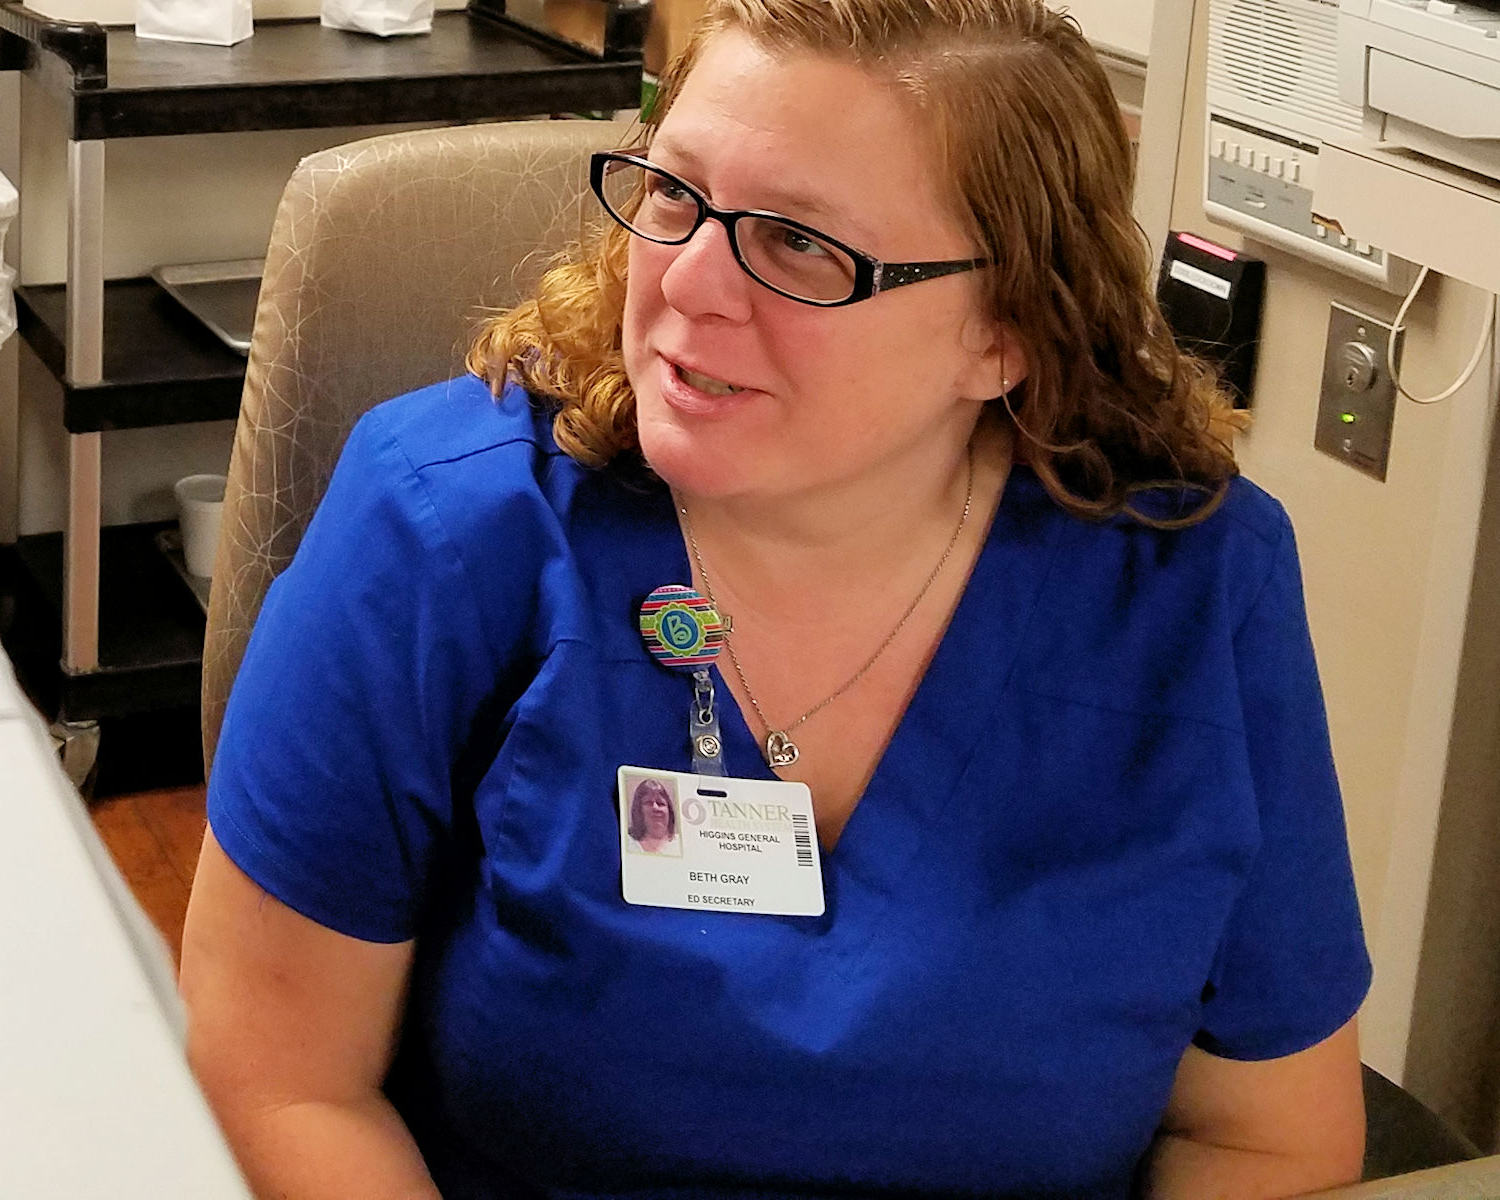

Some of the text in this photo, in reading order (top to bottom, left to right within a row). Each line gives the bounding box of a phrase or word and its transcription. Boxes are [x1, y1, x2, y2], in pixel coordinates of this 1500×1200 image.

[666, 614, 693, 645] B
[708, 800, 793, 821] TANNER
[699, 830, 781, 844] HIGGINS GENERAL
[719, 842, 763, 853] HOSPITAL
[689, 871, 750, 885] BETH GRAY
[687, 894, 756, 907] ED SECRETARY
